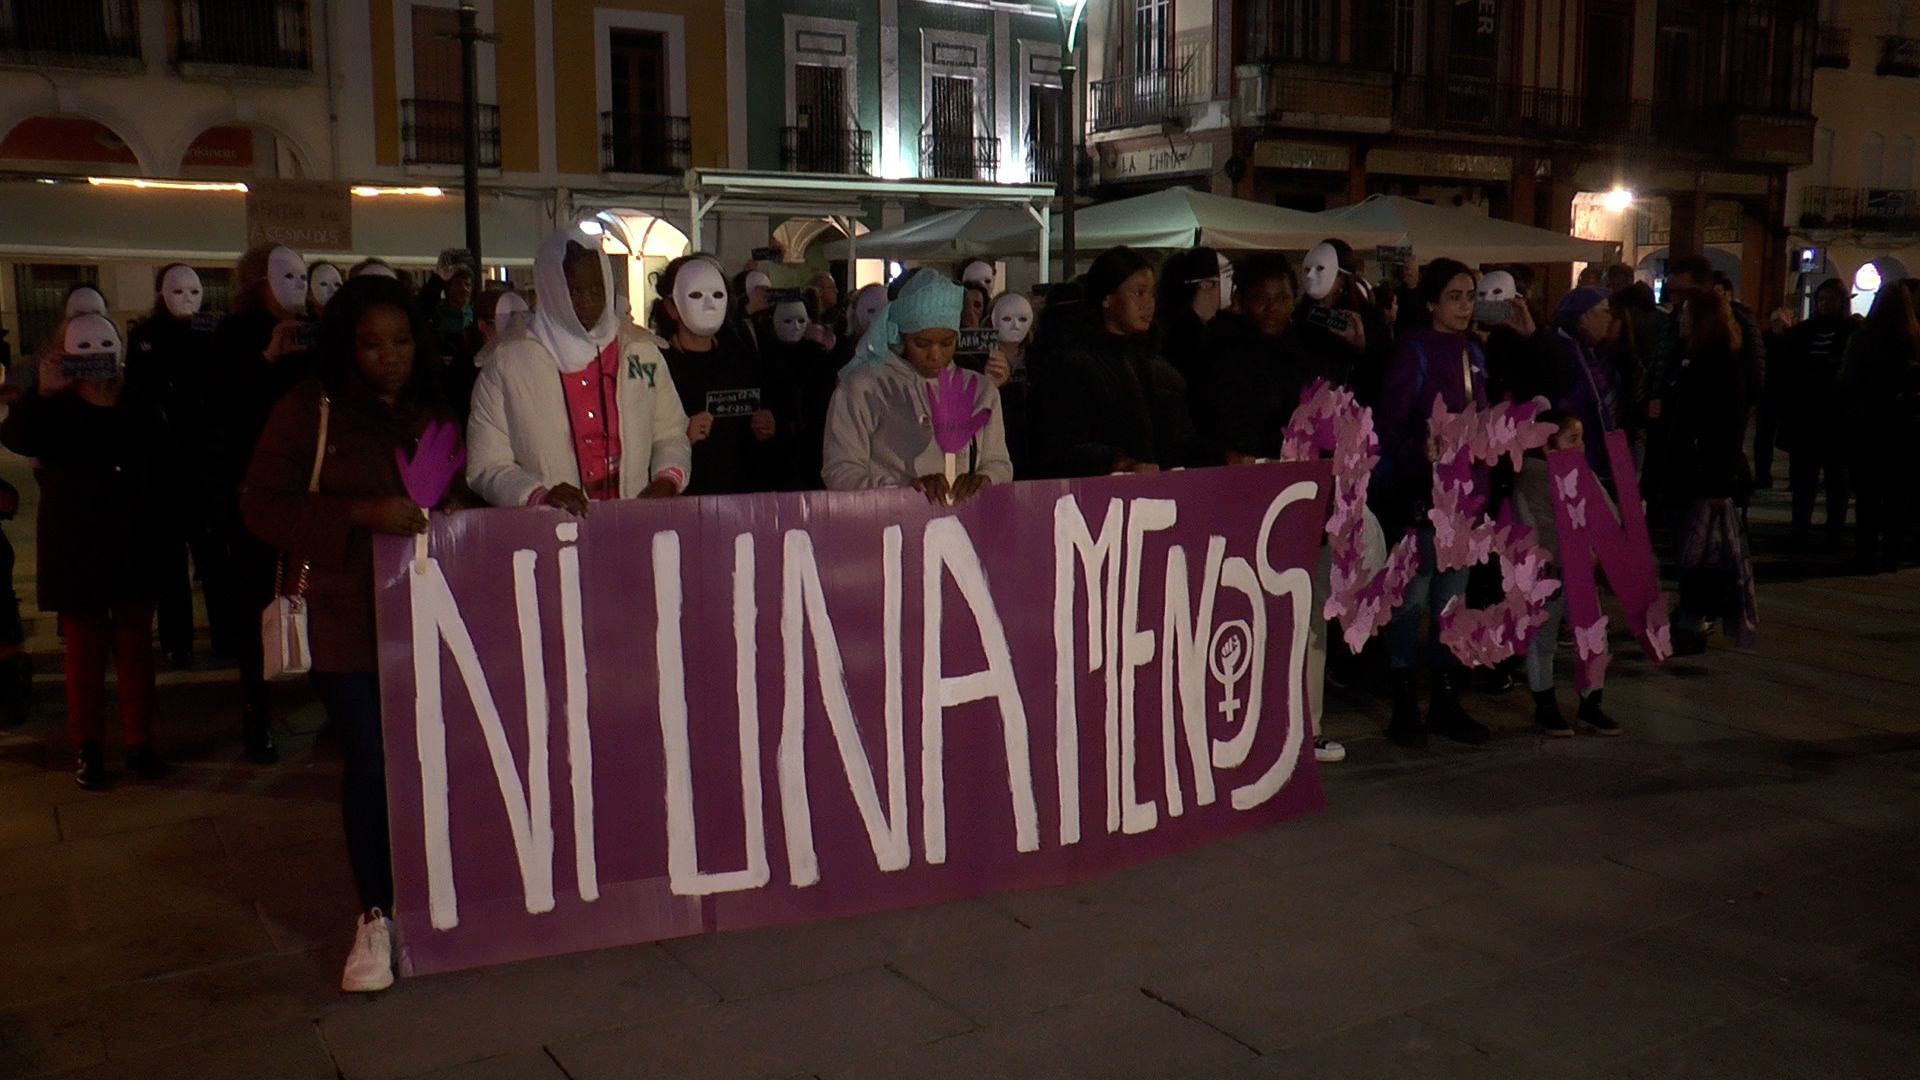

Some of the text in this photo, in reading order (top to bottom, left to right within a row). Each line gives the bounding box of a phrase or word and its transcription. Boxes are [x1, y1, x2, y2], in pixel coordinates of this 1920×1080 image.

[627, 354, 657, 387] NY
[651, 514, 1041, 895] UNA
[1053, 480, 1319, 847] MENOS
